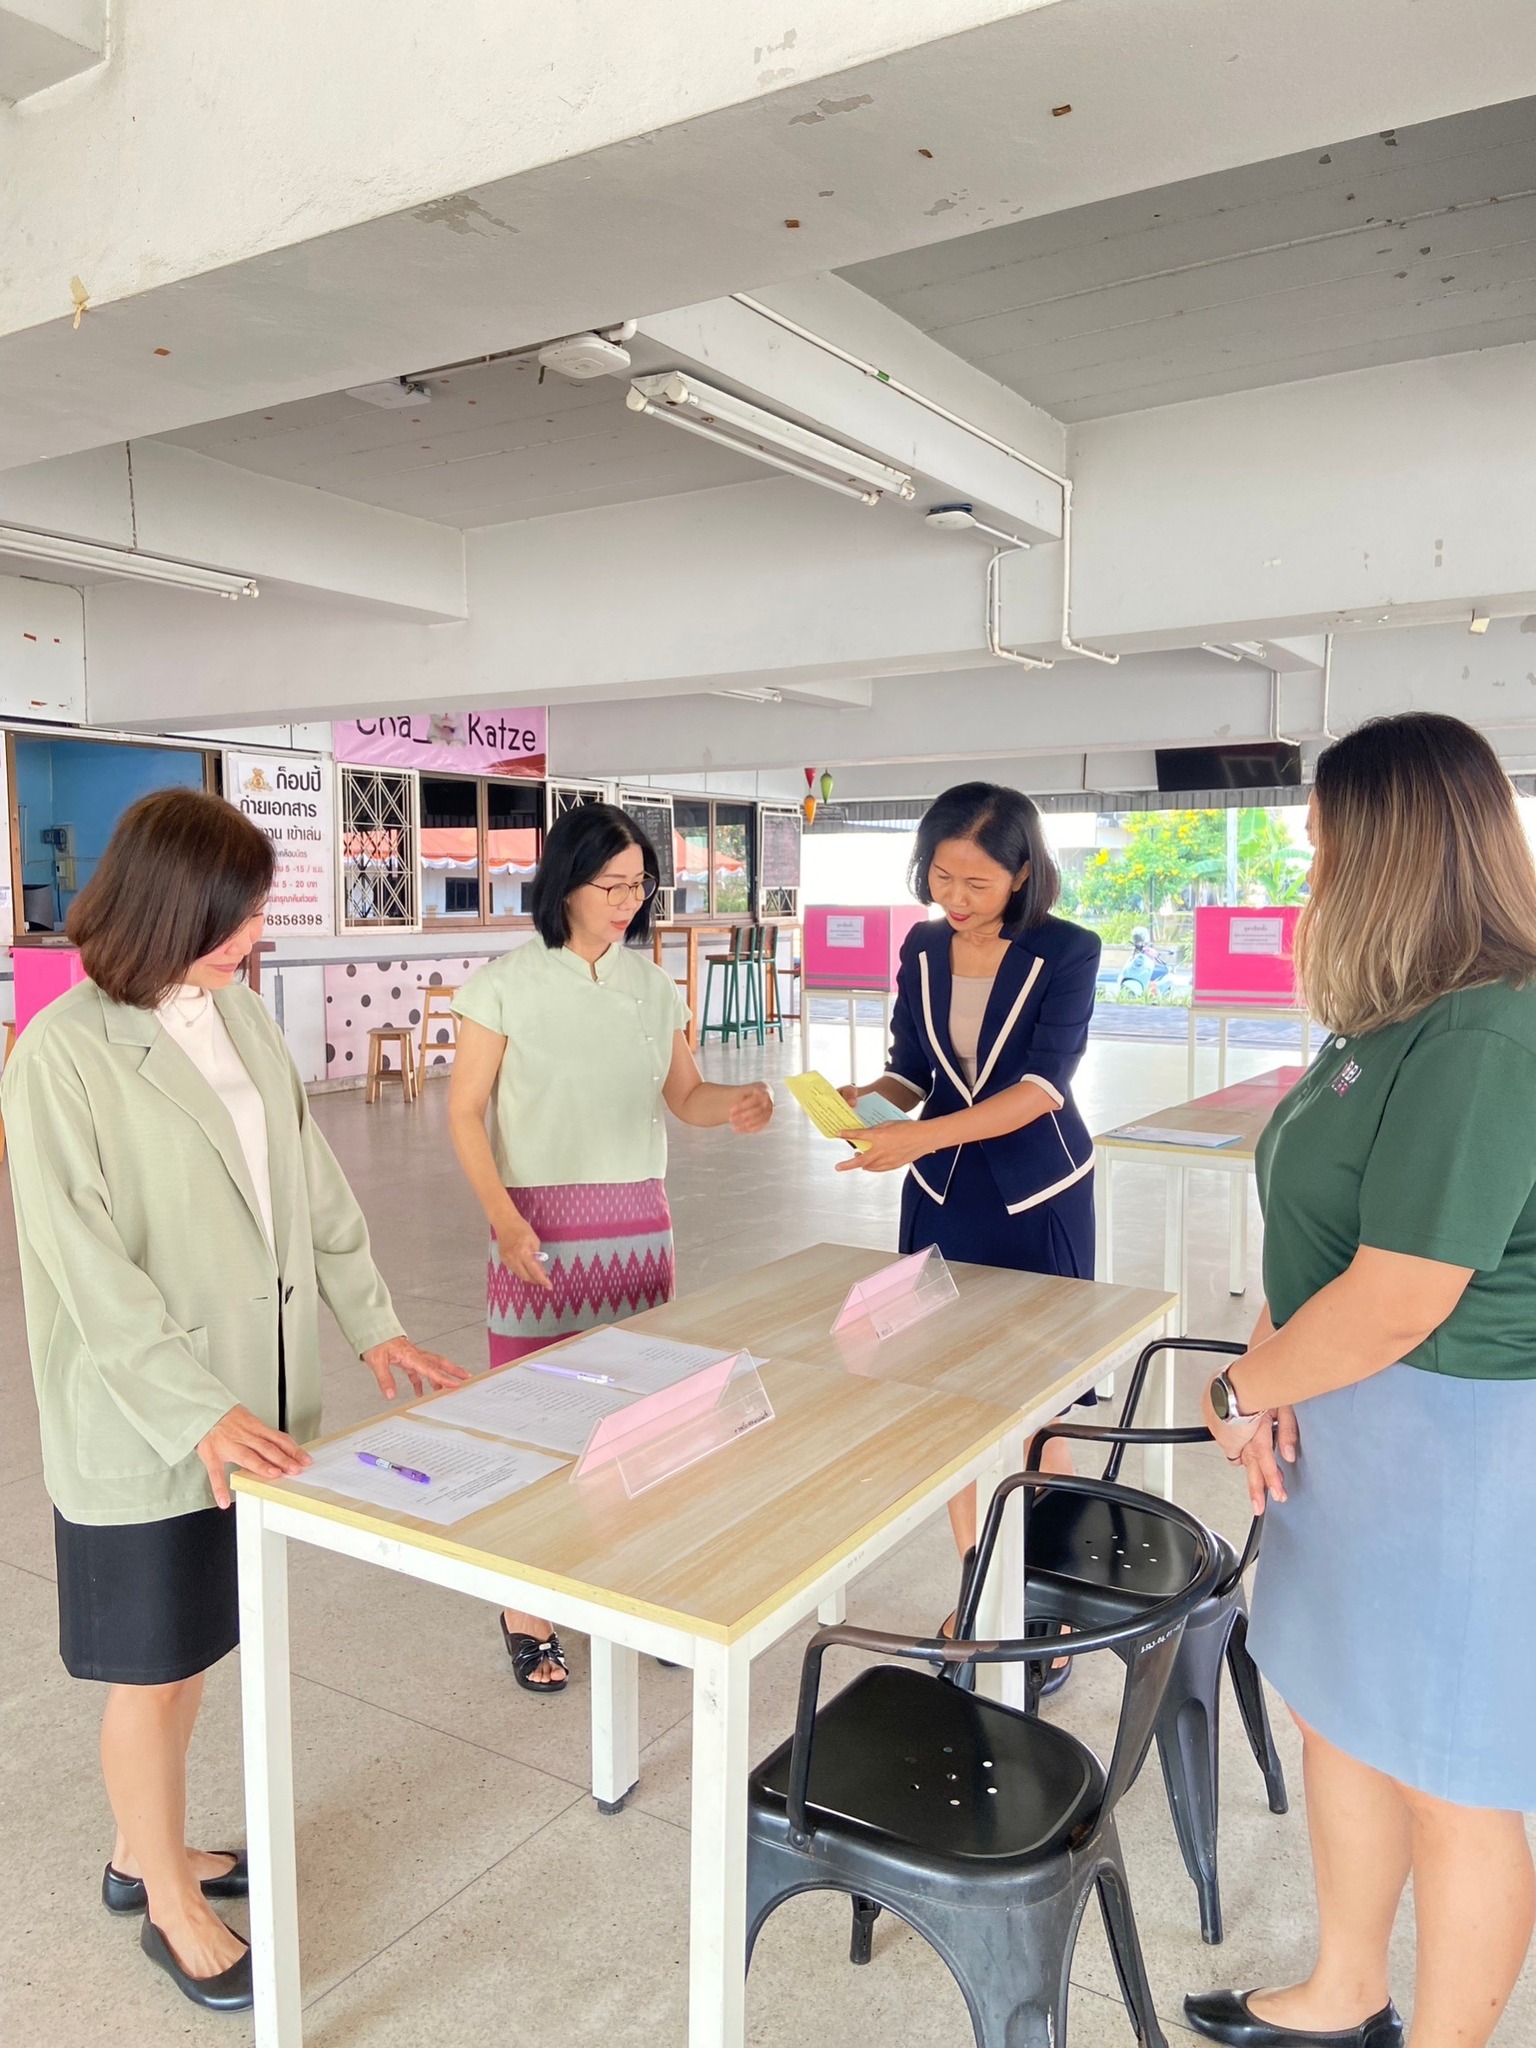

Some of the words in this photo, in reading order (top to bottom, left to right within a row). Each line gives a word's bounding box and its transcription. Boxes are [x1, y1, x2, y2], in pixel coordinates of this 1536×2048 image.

[468, 713, 536, 751] Katze
[276, 765, 321, 792] ก็อปปี้
[240, 795, 317, 818] ถ่ายเอกสาร
[287, 825, 322, 841] เข้าเล่ม
[263, 914, 323, 926] 6356398
